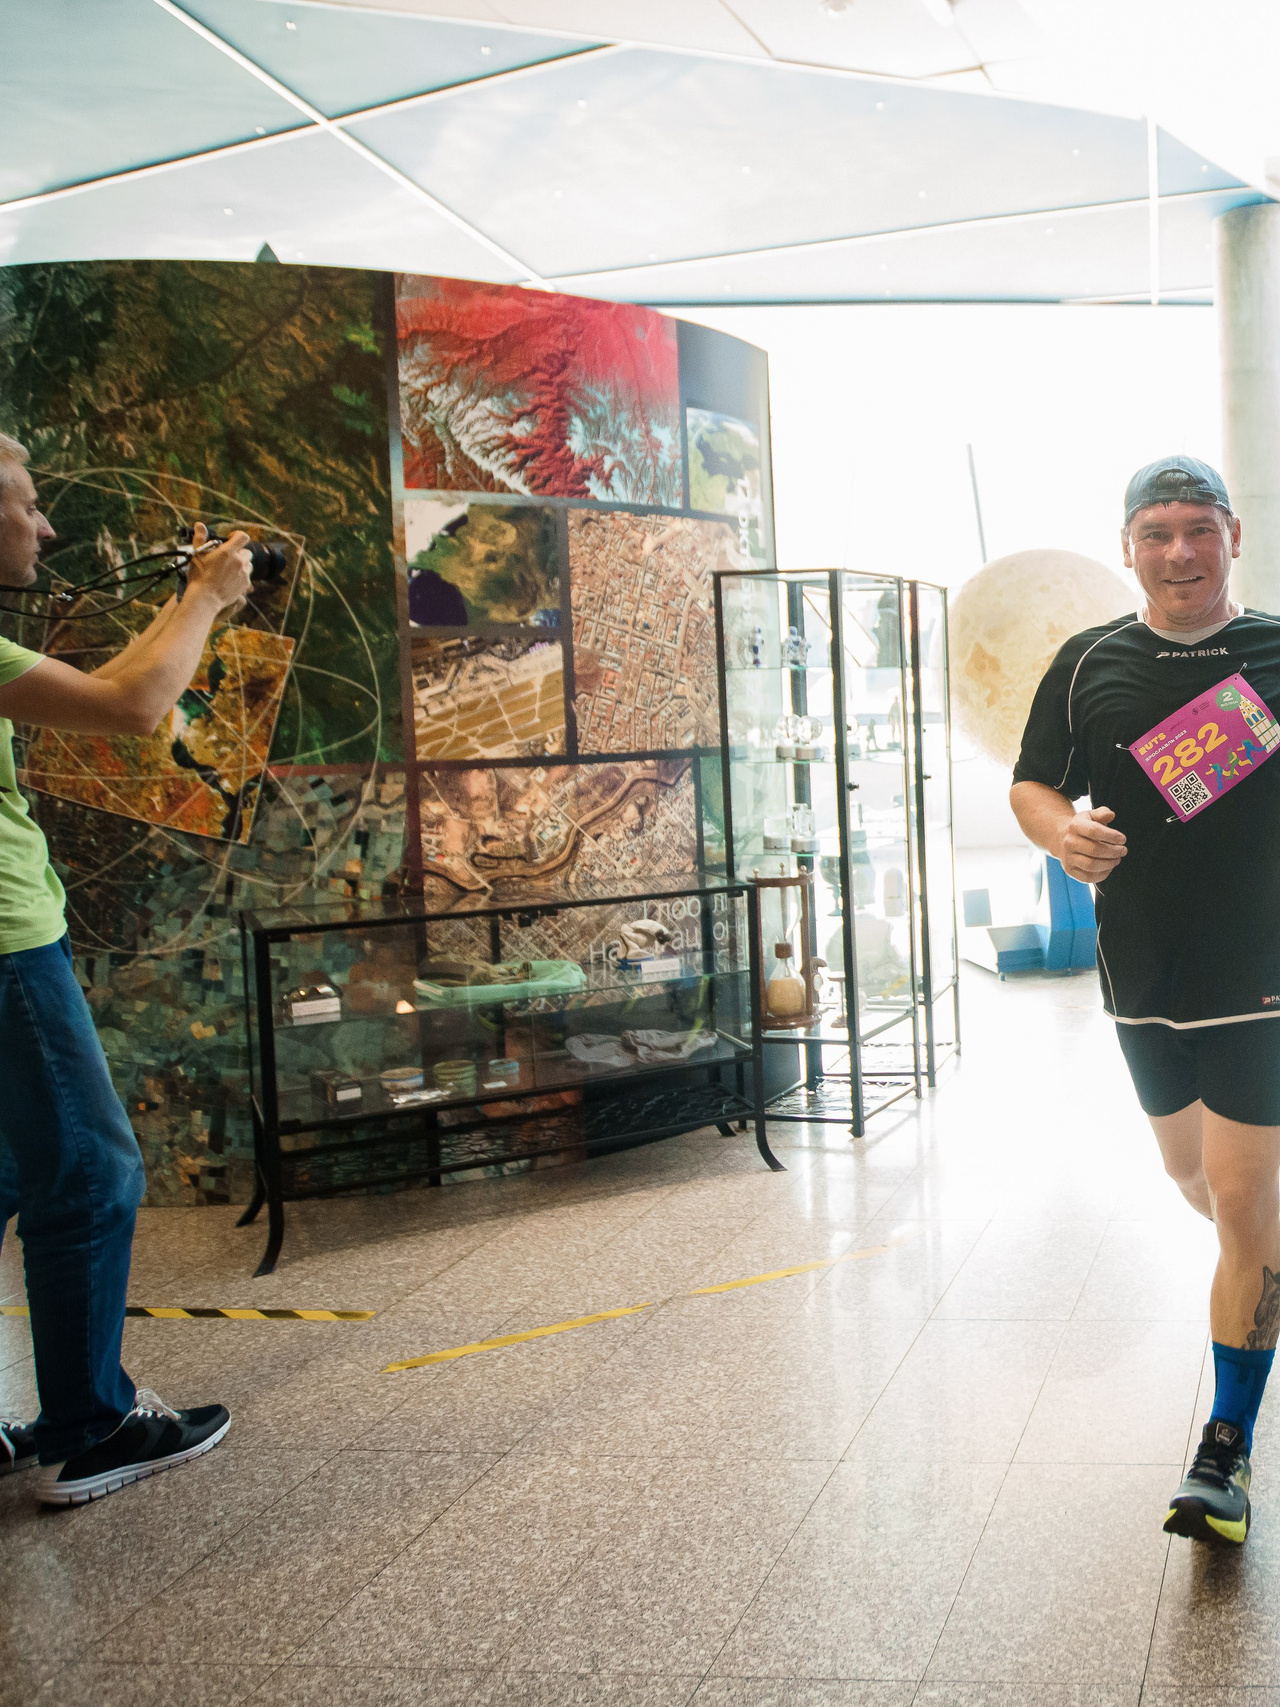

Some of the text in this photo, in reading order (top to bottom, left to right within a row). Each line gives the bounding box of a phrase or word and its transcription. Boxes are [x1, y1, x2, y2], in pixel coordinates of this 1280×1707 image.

[1172, 647, 1229, 658] PATRICK
[1222, 691, 1233, 702] 2
[1145, 739, 1175, 762] ЯРОСЛАВЛЬ
[1152, 722, 1229, 787] 282
